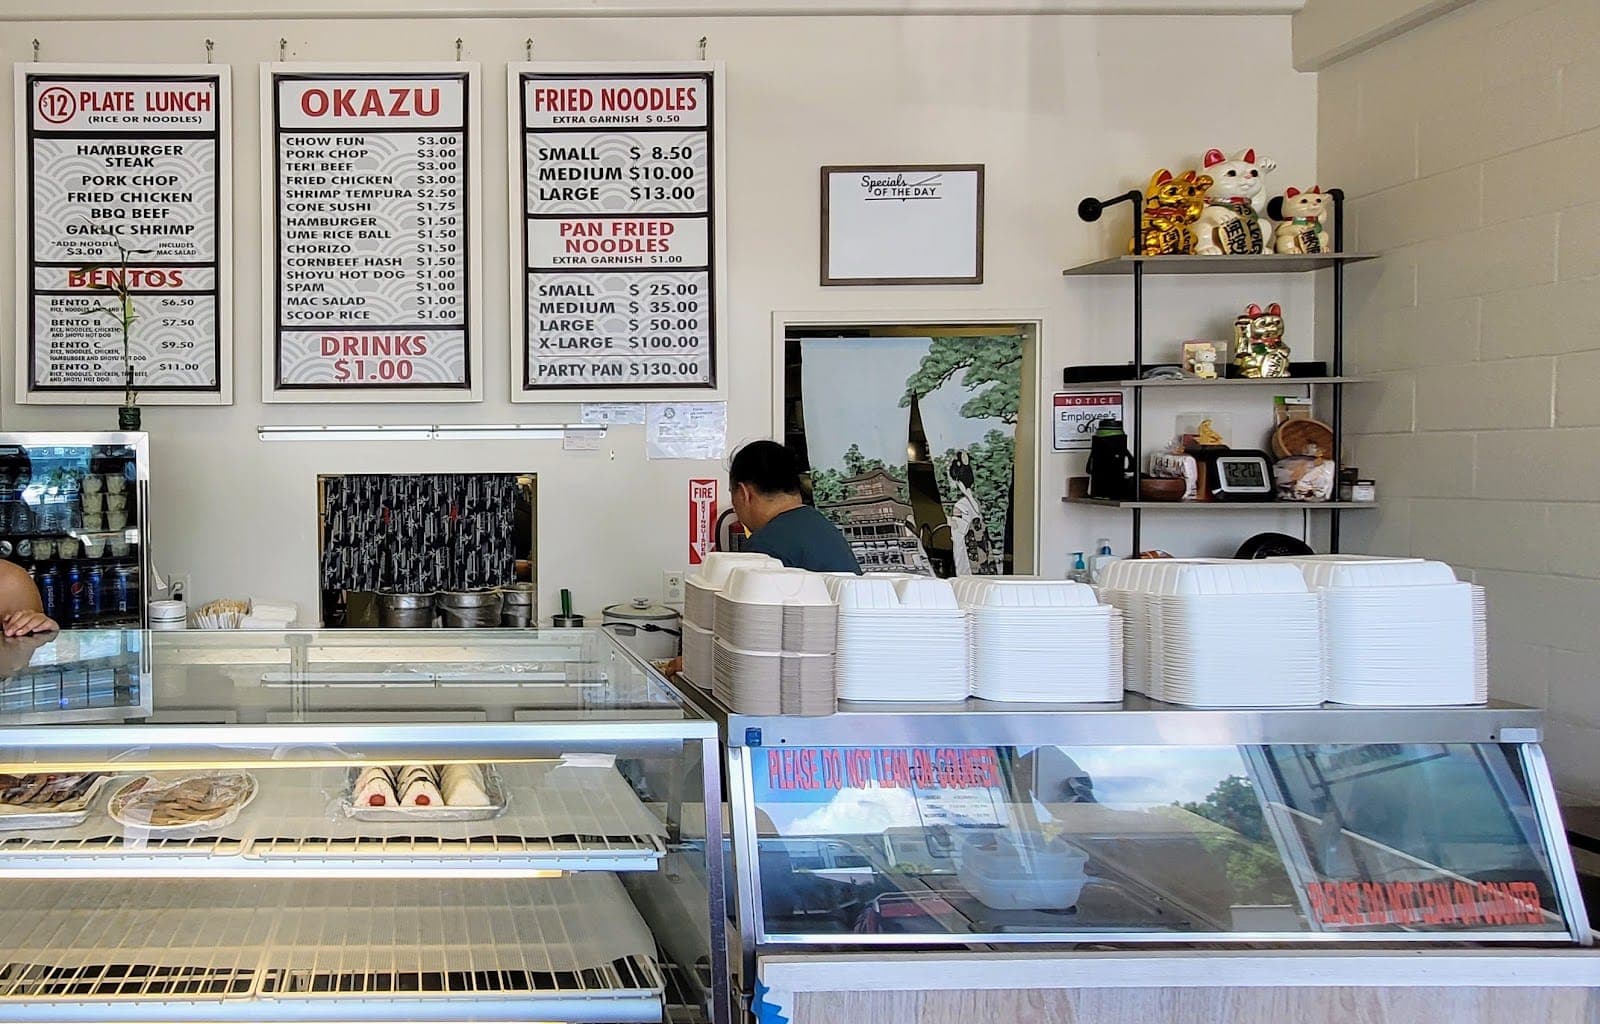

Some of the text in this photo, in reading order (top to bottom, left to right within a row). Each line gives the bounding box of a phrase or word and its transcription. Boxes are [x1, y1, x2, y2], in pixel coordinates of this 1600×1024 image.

[43, 92, 211, 116] $12 PLATE LUNCH
[301, 88, 440, 117] OKAZU
[536, 88, 697, 112] FRIED NOODLES
[89, 116, 119, 124] (RICE
[144, 116, 202, 124] NOODLES)
[553, 116, 586, 124] EXTRA
[590, 116, 639, 124] GARNISH
[286, 137, 456, 146] CHOW FUN $3.00
[77, 146, 184, 156] HAMBURGER
[287, 150, 456, 159] PORK CHOP $3.00
[539, 148, 600, 160] SMALL
[106, 158, 155, 168] STEAK
[287, 162, 456, 171] TERI BEEF $3.00
[539, 167, 694, 181] MEDIUM $10.00
[82, 176, 179, 186] PORK CHOP
[287, 176, 456, 185] FRIED CHICKEN $3.00
[861, 174, 908, 192] Specials
[286, 189, 456, 199] SHRIMP TEMPURA $2.50
[540, 187, 695, 202] LARGE $13.00
[874, 188, 937, 196] OF THE DAY
[68, 193, 193, 202] FRIED CHICKEN
[287, 202, 456, 212] CONE SUSHI $1.75
[91, 209, 170, 219] BBQ BEEF
[287, 217, 456, 226] HAMBURGER $1.50
[66, 225, 195, 236] GARLIC SHRIMP
[560, 222, 674, 236] PAN FRIED
[287, 230, 457, 239] UME RICE BALL $1.50
[287, 244, 456, 254] CHORIZO $1.50
[566, 239, 670, 253] NOODLES
[67, 248, 103, 256] $3.00
[287, 258, 456, 267] CORNBEEF HASH $1.50
[553, 256, 682, 264] EXTRA GARNISH $1.00
[68, 270, 184, 288] BENTOS
[287, 270, 455, 280] SHOYU HOT DOG $1.00
[287, 283, 455, 292] SPAM $1.00
[540, 285, 594, 297] SMALL
[287, 297, 456, 306] MAC SALAD $1.00
[540, 302, 616, 314] MEDIUM
[287, 311, 456, 320] SCOOP RICE $1.00
[540, 320, 594, 332] LARGE
[161, 341, 194, 349] $9.50
[321, 336, 428, 356] DRINKS
[540, 336, 699, 349] X-LARGE $100.00
[160, 363, 199, 371] $11.00
[334, 358, 413, 382] $1.00
[539, 363, 698, 377] PARTY PAN $130.00
[1078, 424, 1098, 433] Onl
[695, 488, 713, 498] FIRE
[768, 749, 820, 790] PLEASE
[821, 749, 842, 790] DO
[844, 749, 872, 790] NOT
[874, 749, 912, 790] LEAN
[913, 748, 933, 790] ON
[935, 748, 1002, 790] COUNTER
[1308, 882, 1365, 924] PLEASE
[1477, 882, 1545, 924] COUNTER
